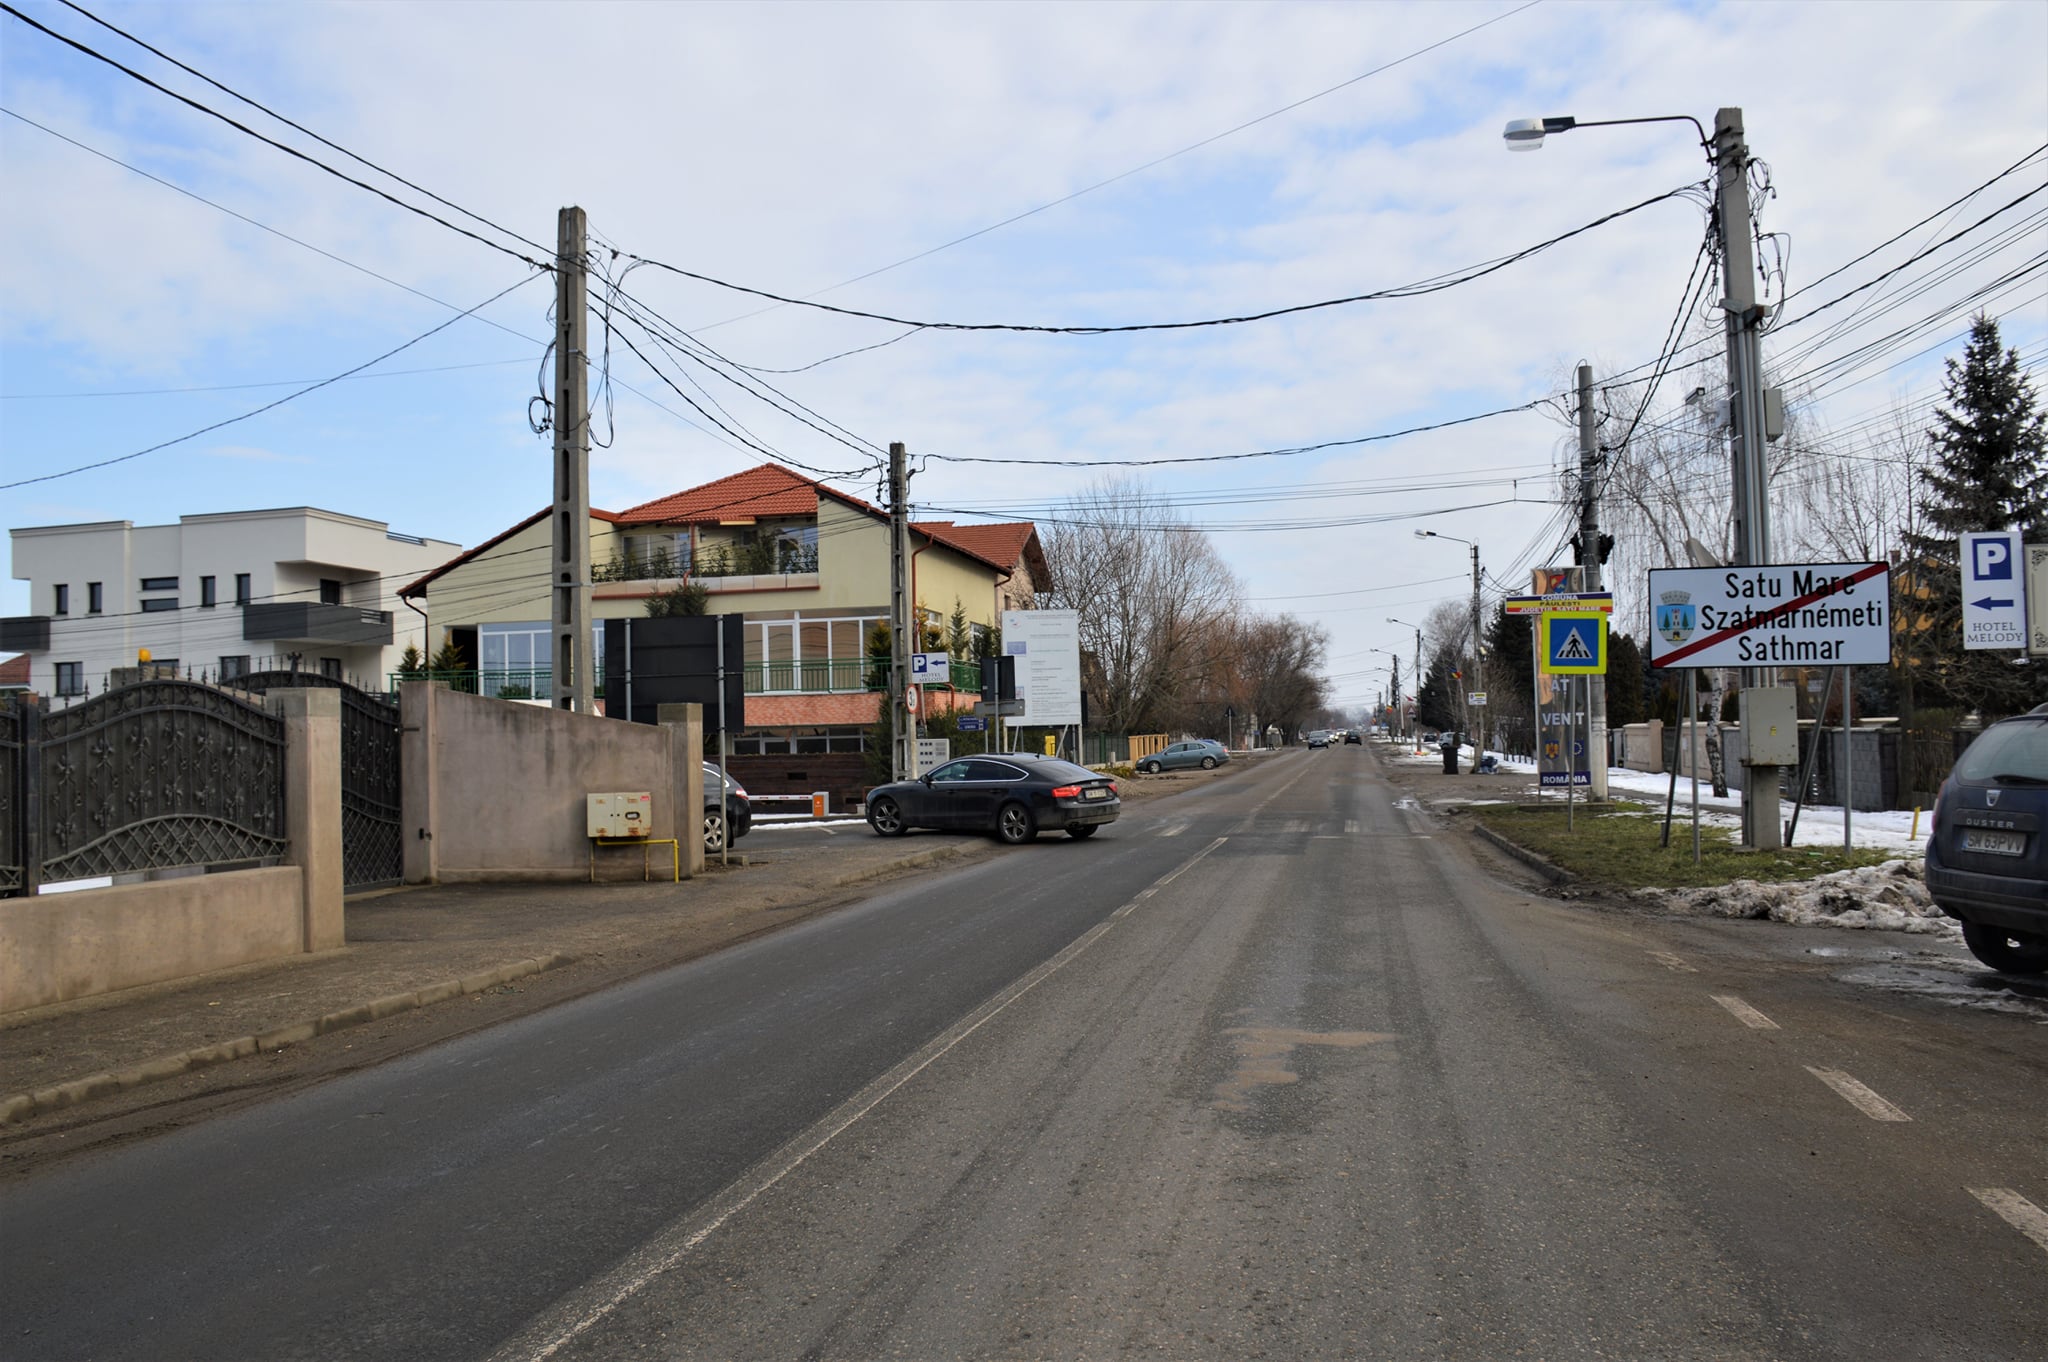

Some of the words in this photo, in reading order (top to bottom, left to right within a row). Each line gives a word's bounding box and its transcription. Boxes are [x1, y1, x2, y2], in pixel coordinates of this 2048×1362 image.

[1977, 543, 2007, 575] P
[1725, 572, 1781, 599] Satu
[1793, 570, 1856, 597] Mare
[1701, 601, 1882, 631] Szatmárnémeti
[1973, 622, 2016, 632] HOTEL
[1967, 632, 2023, 643] MELODY
[1739, 635, 1844, 662] Sathmar
[913, 656, 926, 672] P
[1542, 711, 1584, 726] VENT
[1966, 818, 2015, 829] DUSTER
